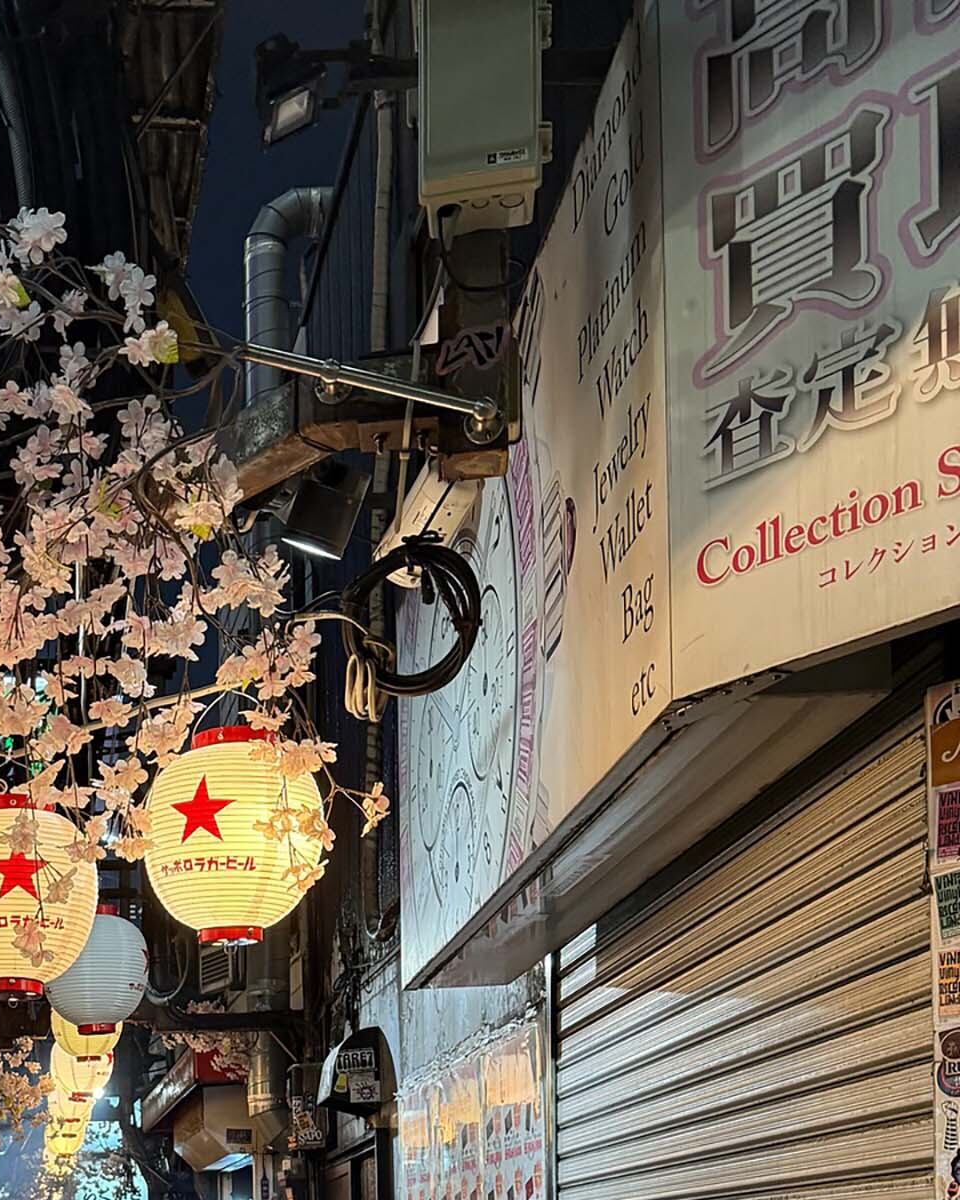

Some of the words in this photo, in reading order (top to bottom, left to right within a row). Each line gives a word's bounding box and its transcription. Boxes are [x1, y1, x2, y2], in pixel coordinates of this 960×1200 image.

[570, 52, 642, 234] Diamond
[603, 130, 645, 238] Gold
[577, 220, 648, 385] Platinum
[595, 304, 649, 422] Watch
[593, 392, 652, 530] Jewelry
[696, 480, 922, 586] Collection
[937, 445, 960, 498] S
[599, 482, 653, 586] Wallet
[621, 572, 655, 644] Bag
[630, 660, 657, 718] etc
[160, 855, 257, 877] サッポロラガービール
